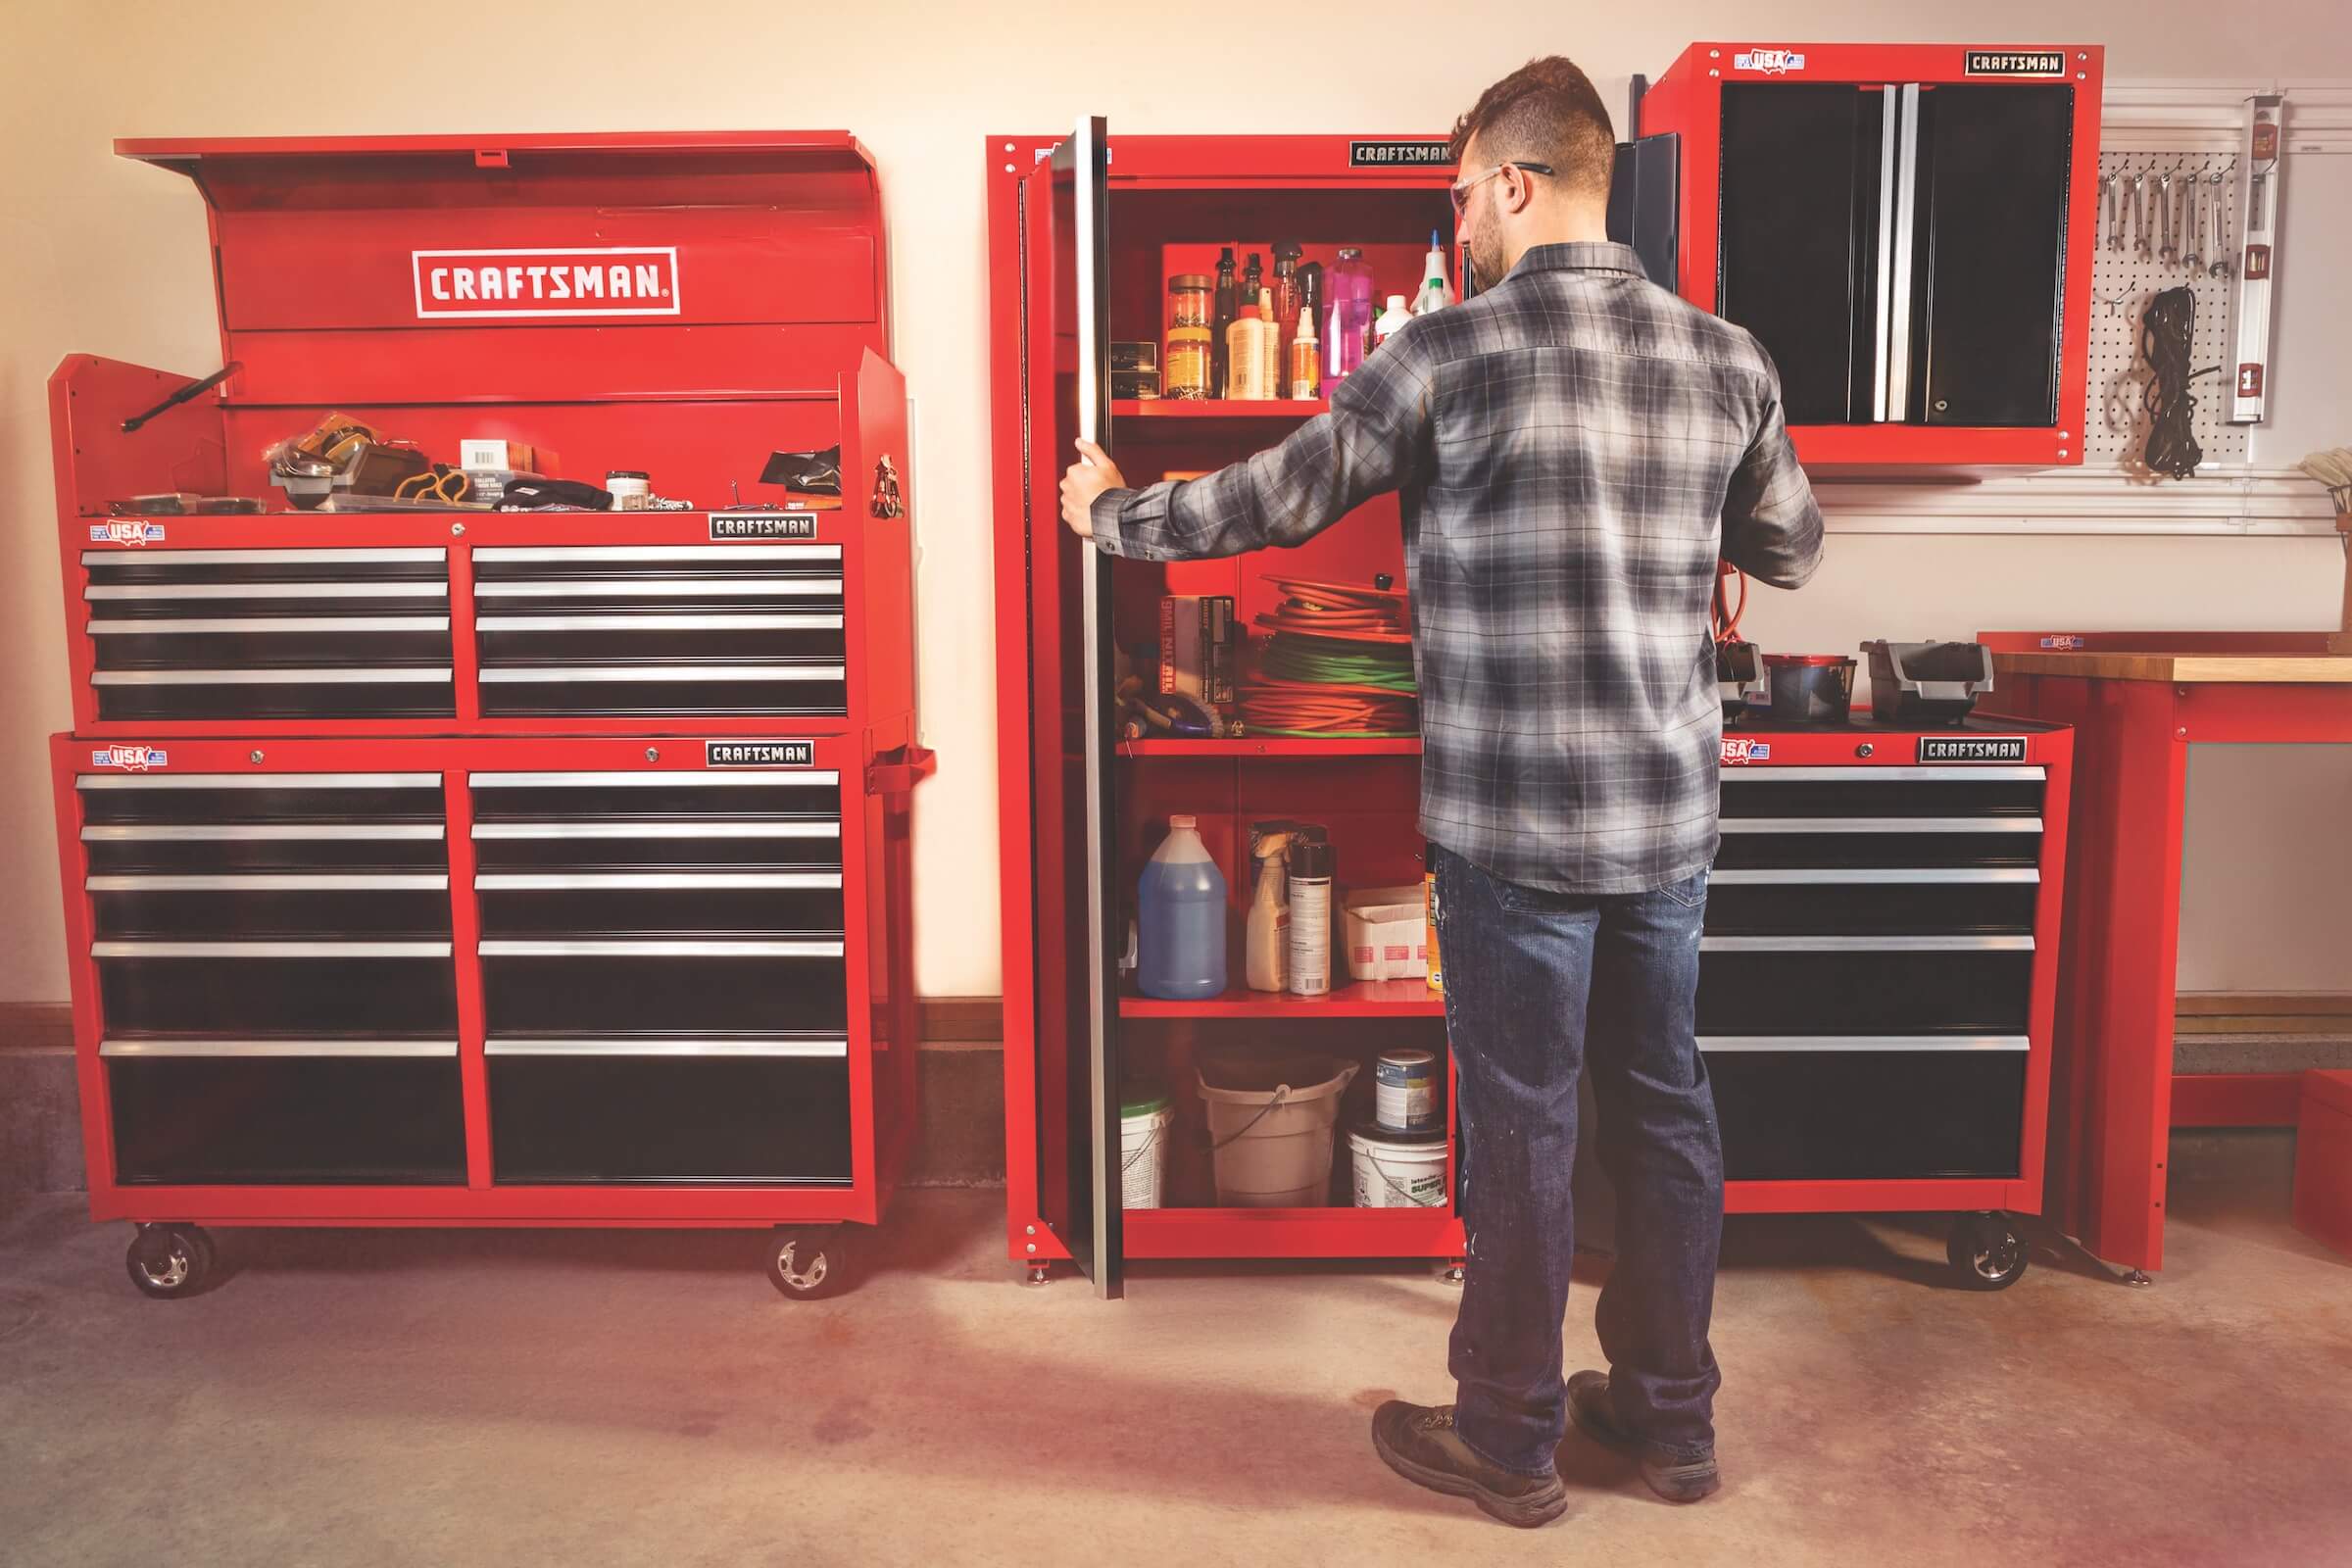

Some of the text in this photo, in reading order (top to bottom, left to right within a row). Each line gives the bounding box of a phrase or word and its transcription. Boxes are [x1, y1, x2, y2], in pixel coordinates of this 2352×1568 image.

[1753, 53, 1785, 69] USA
[1972, 56, 2059, 71] CRAFTSMAN
[1355, 147, 1451, 162] CRAFTSMAN
[110, 523, 144, 540] USA
[715, 519, 809, 534] CRAFTSMAN
[113, 749, 146, 764] USA
[712, 746, 807, 761] CRAFTSMAN
[1928, 743, 2020, 758] CRAFTSMAN
